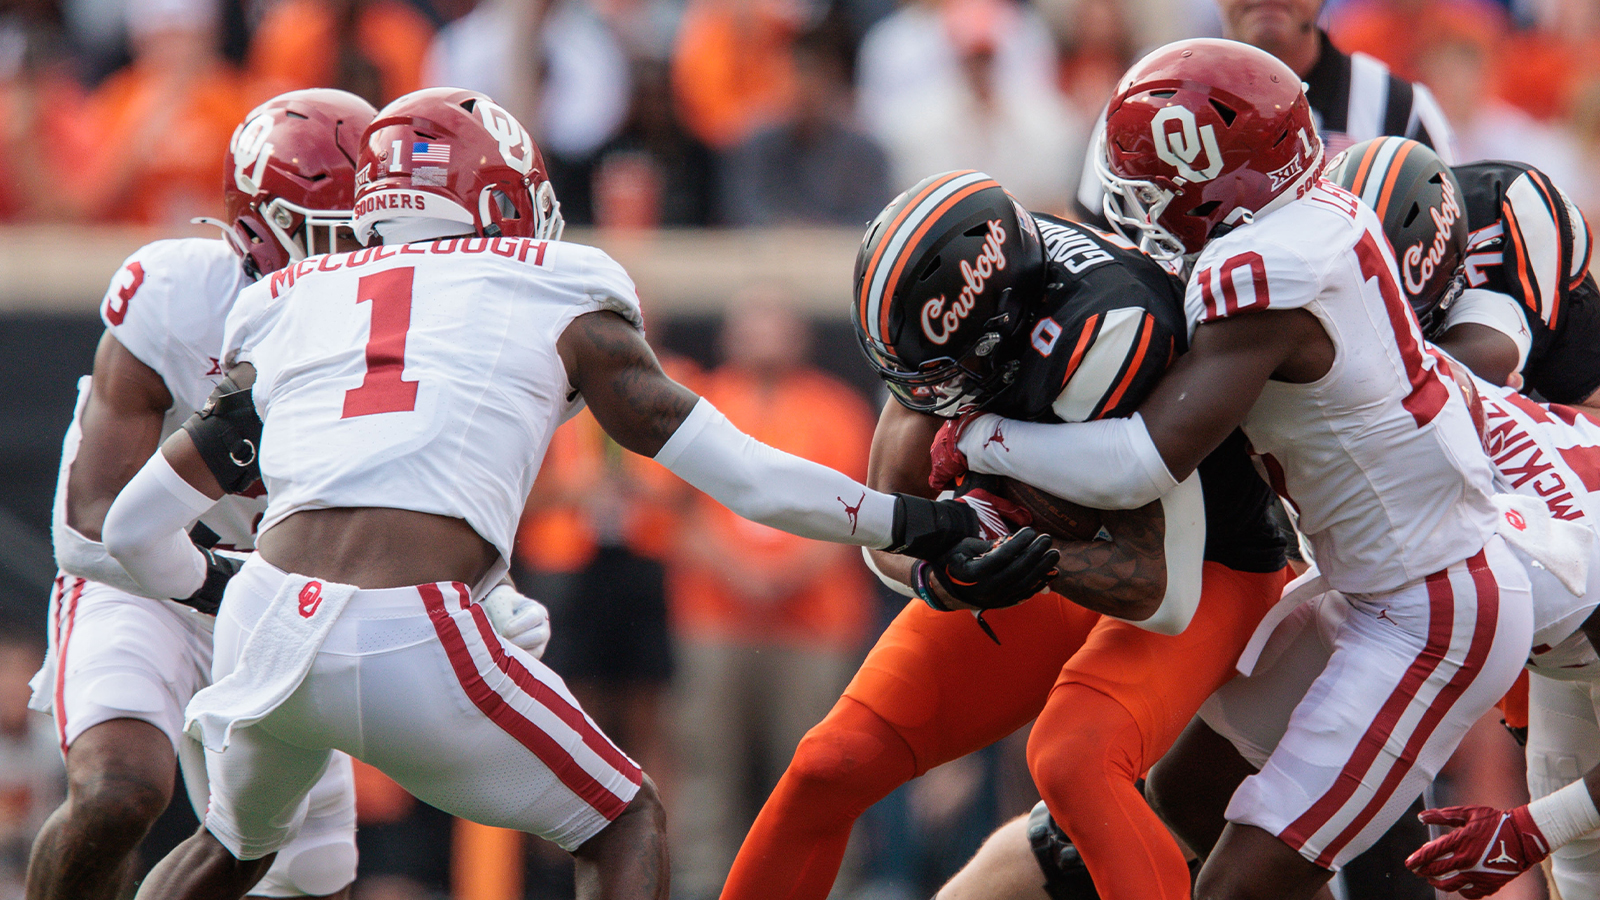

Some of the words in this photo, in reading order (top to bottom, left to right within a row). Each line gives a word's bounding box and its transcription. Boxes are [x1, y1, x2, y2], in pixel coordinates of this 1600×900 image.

[389, 140, 402, 172] 1
[476, 99, 534, 174] OU
[1151, 104, 1225, 183] OU
[354, 194, 425, 220] SOONERS
[1402, 171, 1460, 296] Cowboys
[105, 261, 145, 327] 3
[921, 219, 1007, 345] Cowboys
[1197, 251, 1270, 323] 10
[340, 266, 419, 420] 1
[1031, 316, 1063, 358] 0
[1353, 227, 1454, 429] 1
[297, 581, 323, 617] OU
